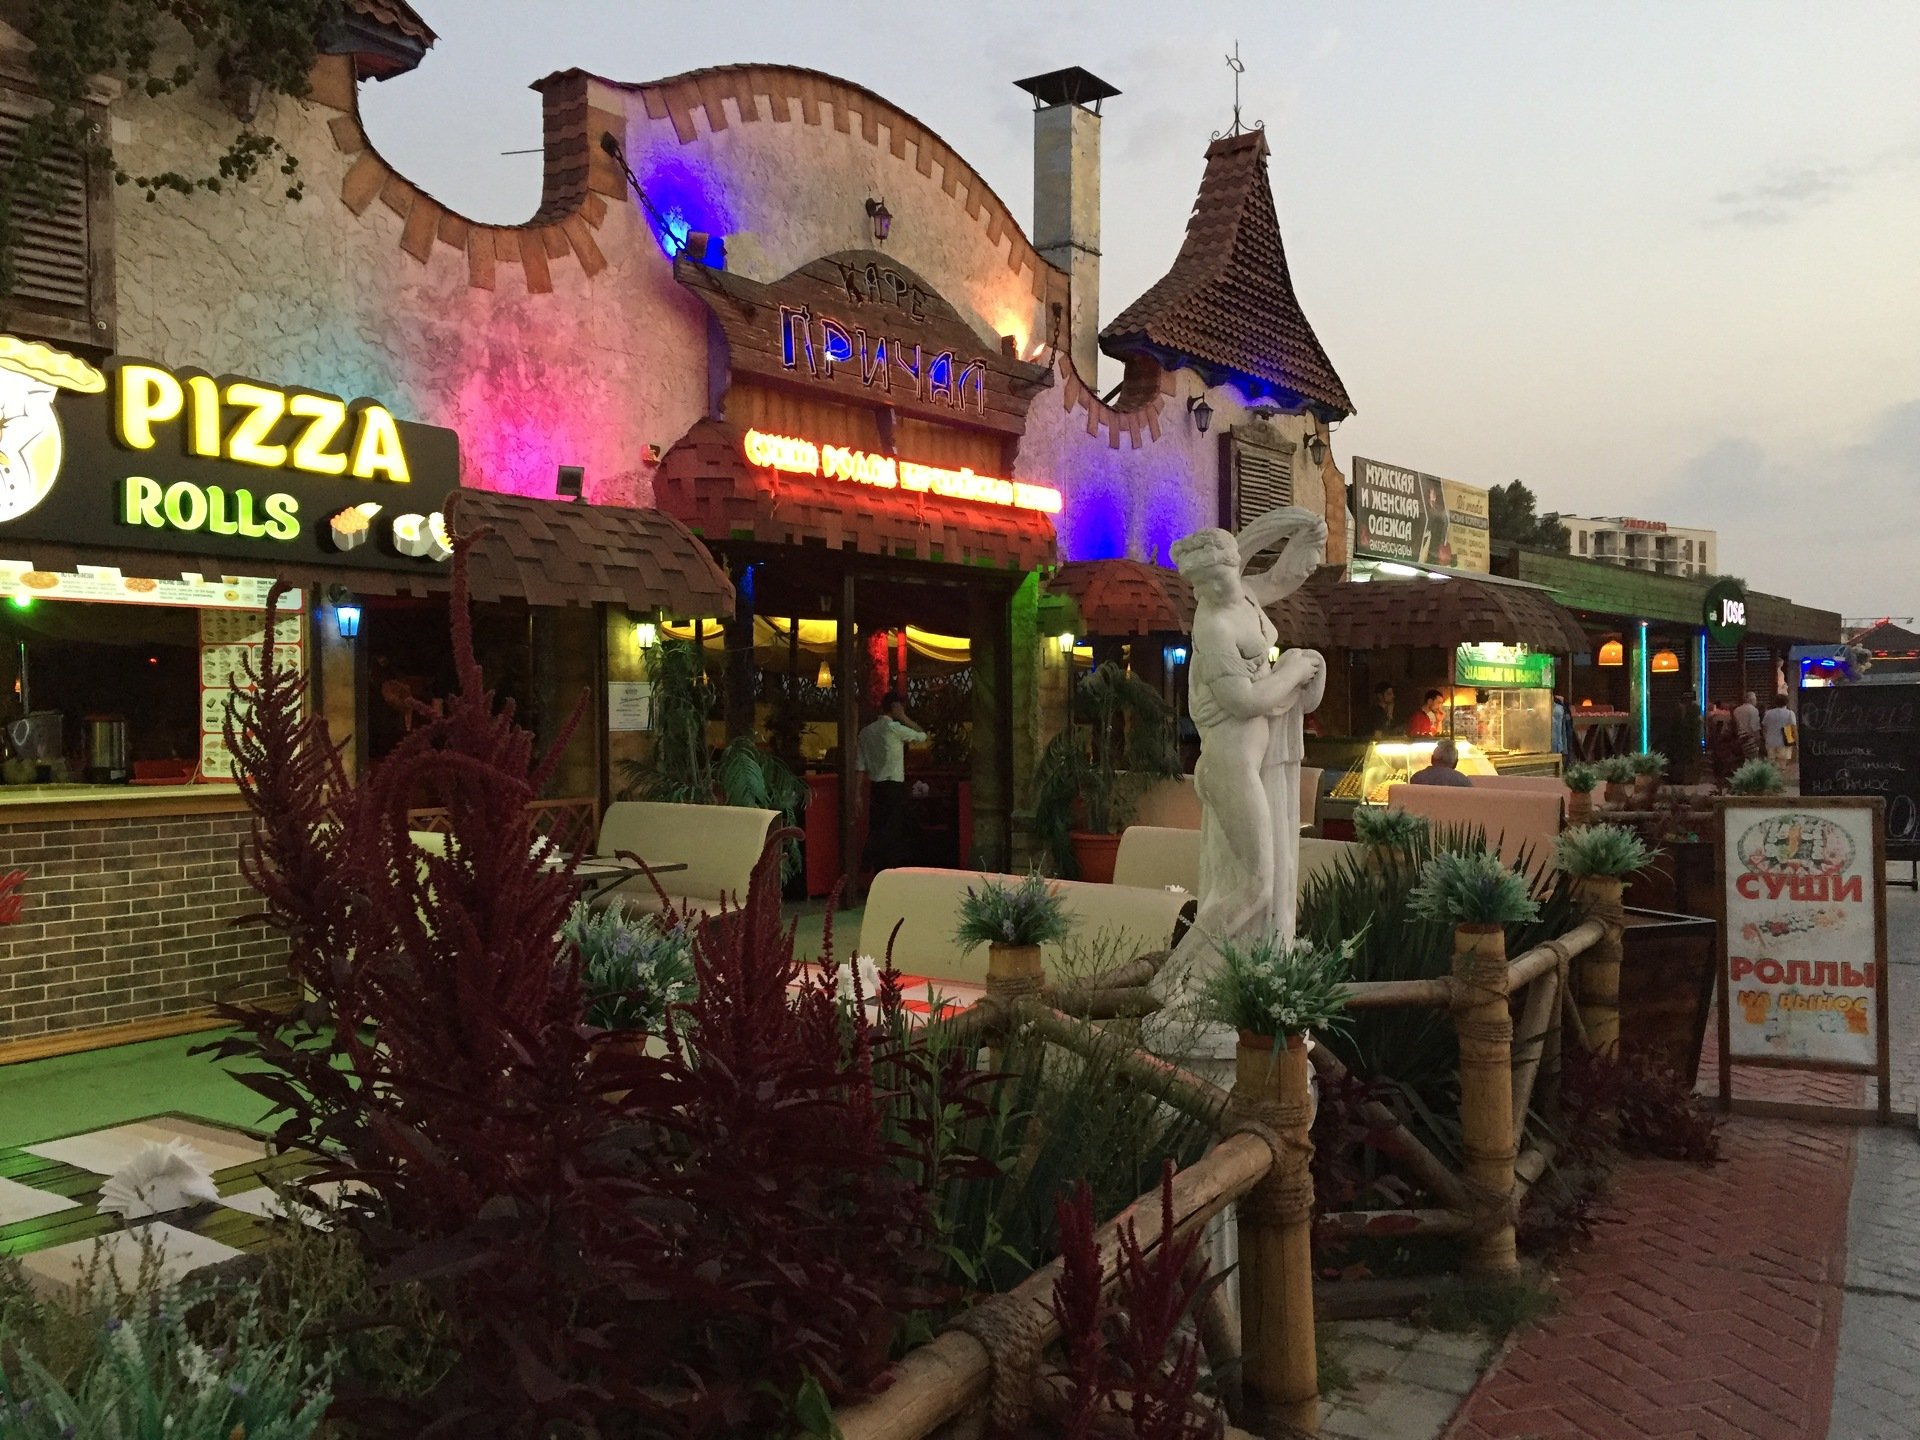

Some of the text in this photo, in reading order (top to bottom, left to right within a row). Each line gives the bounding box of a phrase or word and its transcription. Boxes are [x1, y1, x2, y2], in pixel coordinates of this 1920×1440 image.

[779, 303, 986, 418] ПРИЧАЛ
[117, 363, 411, 483] PIZZA
[1365, 462, 1415, 495] МУЖСКАЯ
[123, 475, 301, 541] ROLLS
[1361, 487, 1369, 508] И
[1371, 489, 1420, 519] ЖЕНСКАЯ
[1368, 514, 1412, 541] ОДЕЖДА
[1369, 538, 1412, 558] аксессуары
[1735, 872, 1862, 902] СУШИ
[1730, 956, 1875, 988] РОЛЛЫ
[1778, 992, 1868, 1013] ВЫНОС
